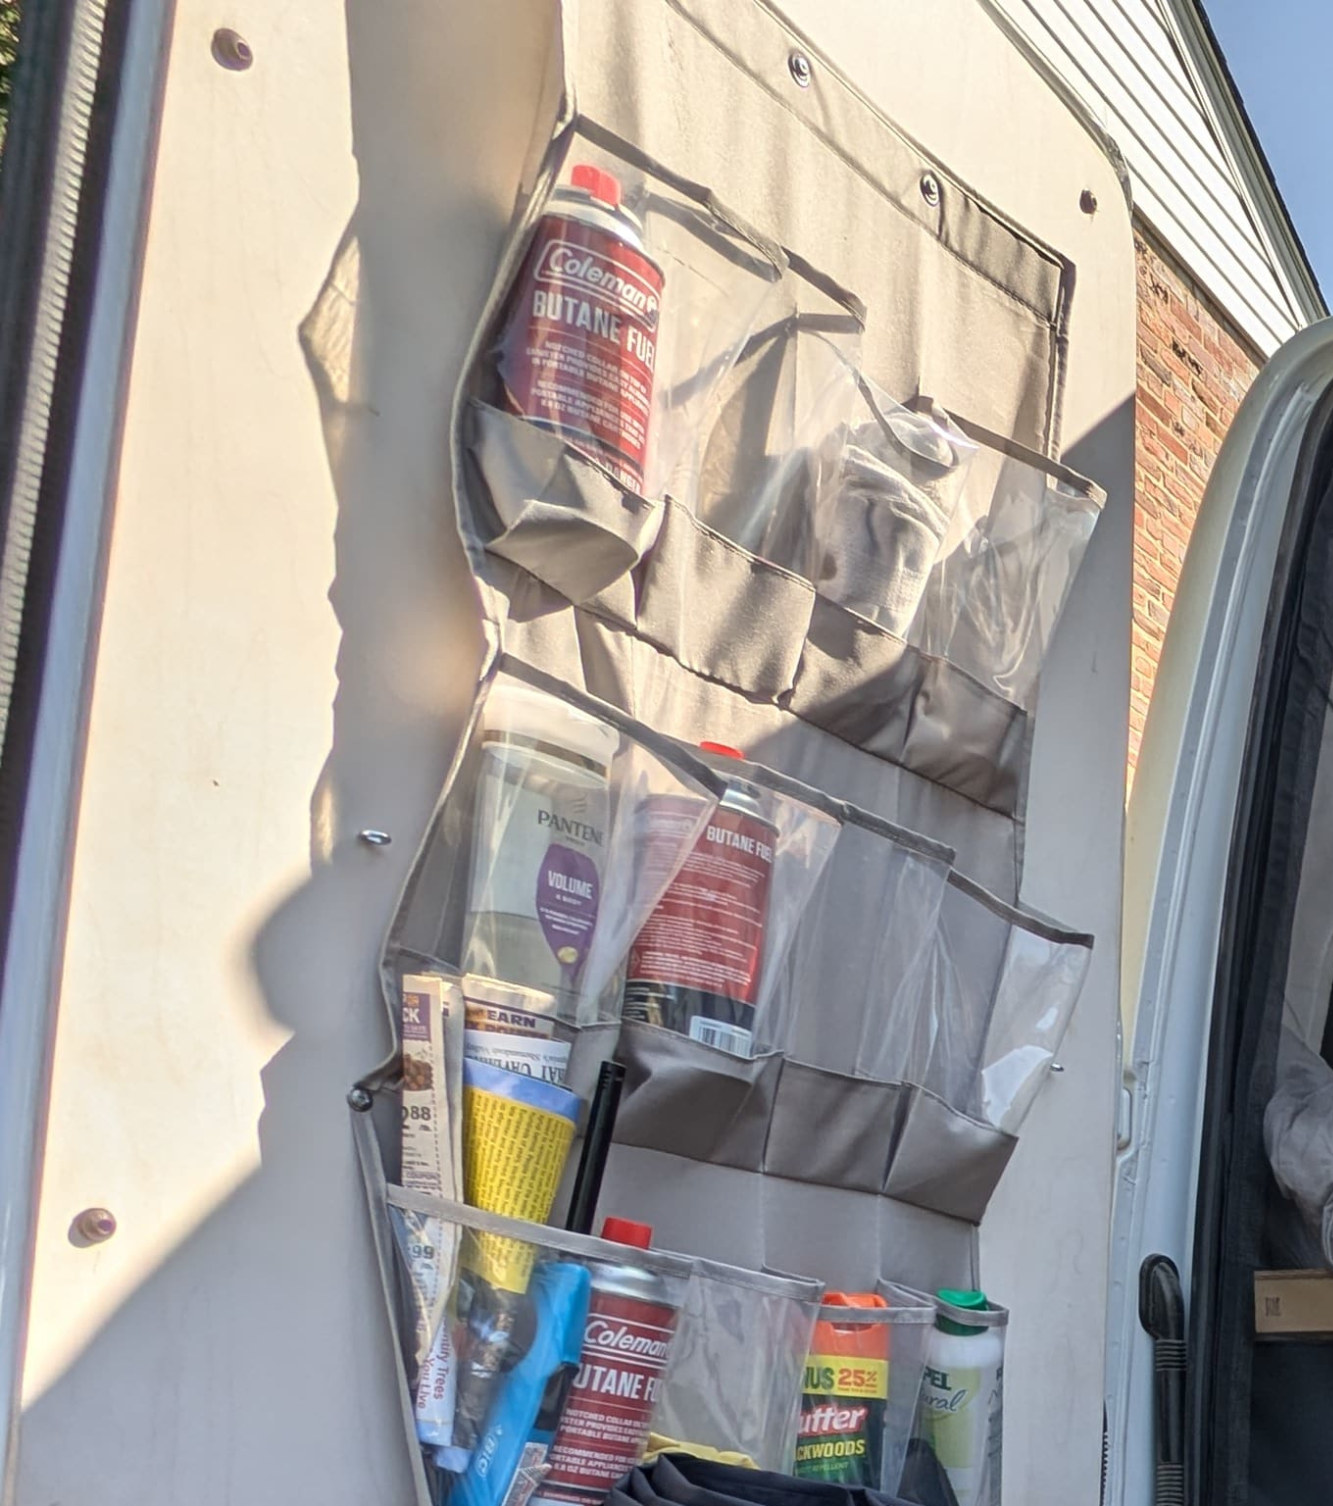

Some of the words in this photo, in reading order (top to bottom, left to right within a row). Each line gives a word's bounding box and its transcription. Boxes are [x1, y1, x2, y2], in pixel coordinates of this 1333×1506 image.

[549, 247, 647, 309] Coleman
[533, 289, 622, 345] BUTANE
[537, 809, 603, 847] PANTEN
[706, 825, 755, 853] BUTANE
[548, 870, 593, 900] VOLUME
[402, 1007, 420, 1024] CK
[487, 1010, 537, 1028] EARN
[433, 1366, 450, 1401] Trees
[573, 1363, 644, 1399] UTANE
[838, 1367, 878, 1389] 25%
[798, 1406, 867, 1434] utter
[796, 1439, 865, 1461] CKWOODS
